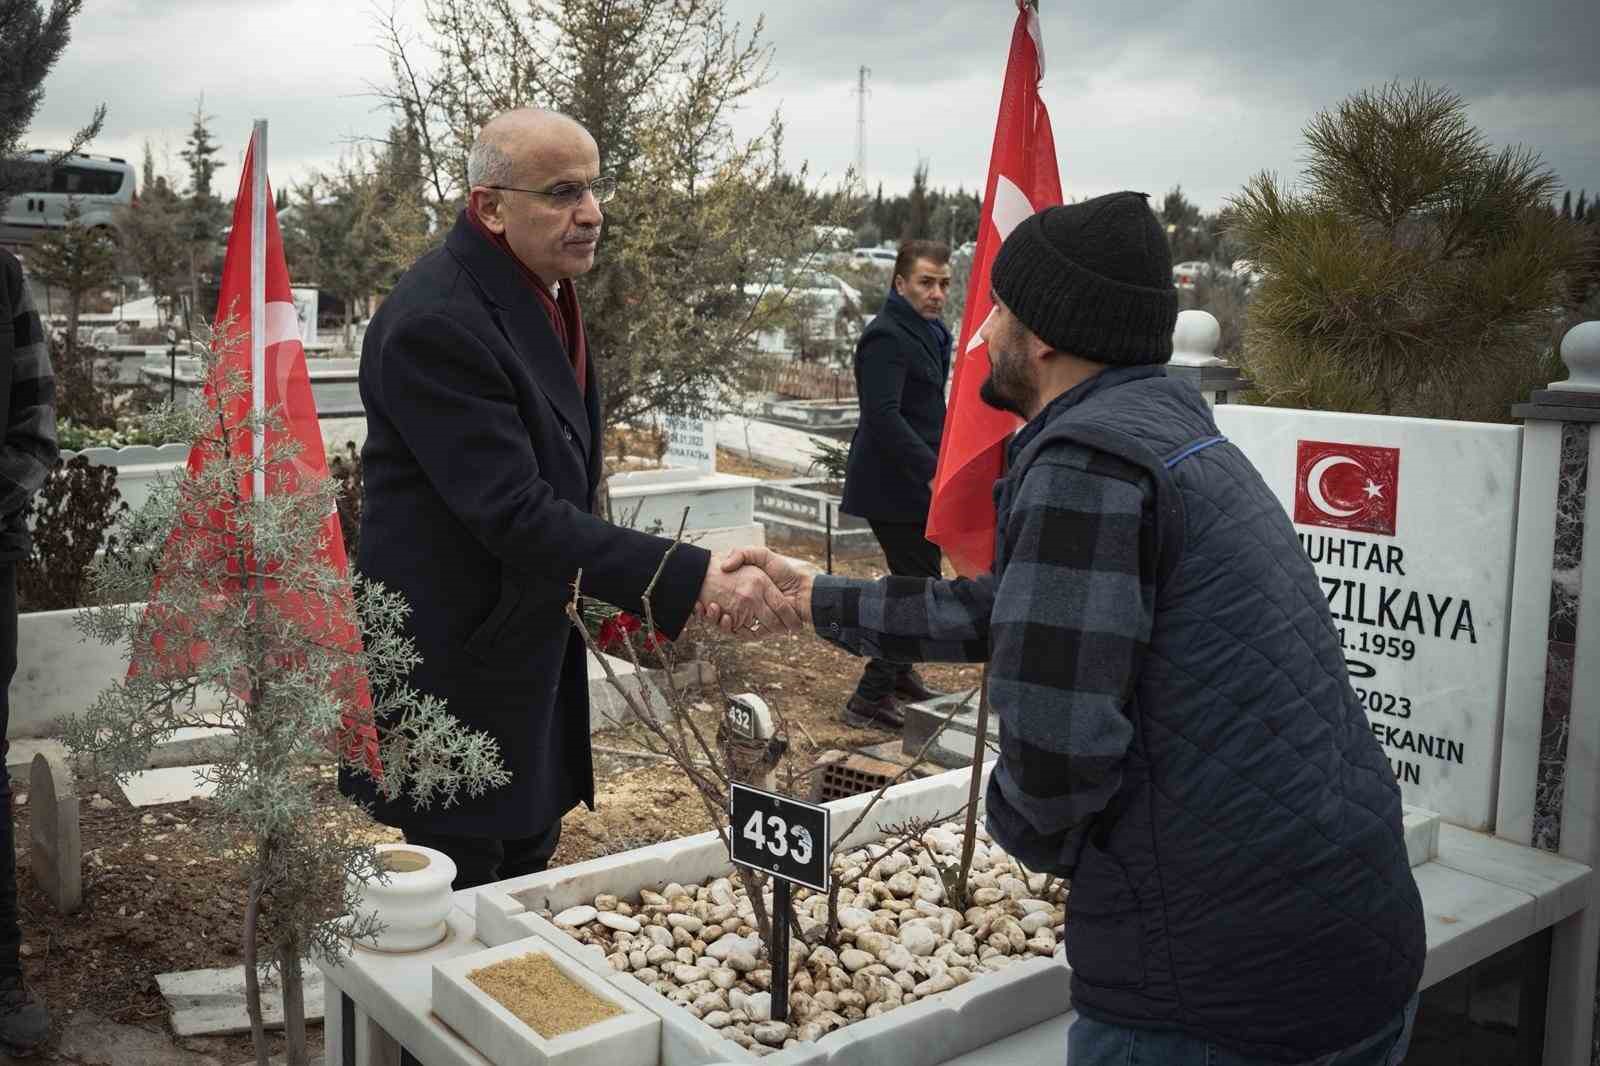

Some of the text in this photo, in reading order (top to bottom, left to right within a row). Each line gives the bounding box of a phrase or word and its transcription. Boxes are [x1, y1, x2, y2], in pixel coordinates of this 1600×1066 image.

[1298, 533, 1406, 576] UHTAR
[1321, 576, 1478, 644] ZILKAYA
[1338, 627, 1416, 661] 1.1959
[729, 706, 750, 730] 432
[1355, 687, 1412, 719] 2023
[1371, 722, 1464, 764] EKANIN
[743, 810, 813, 865] 433
